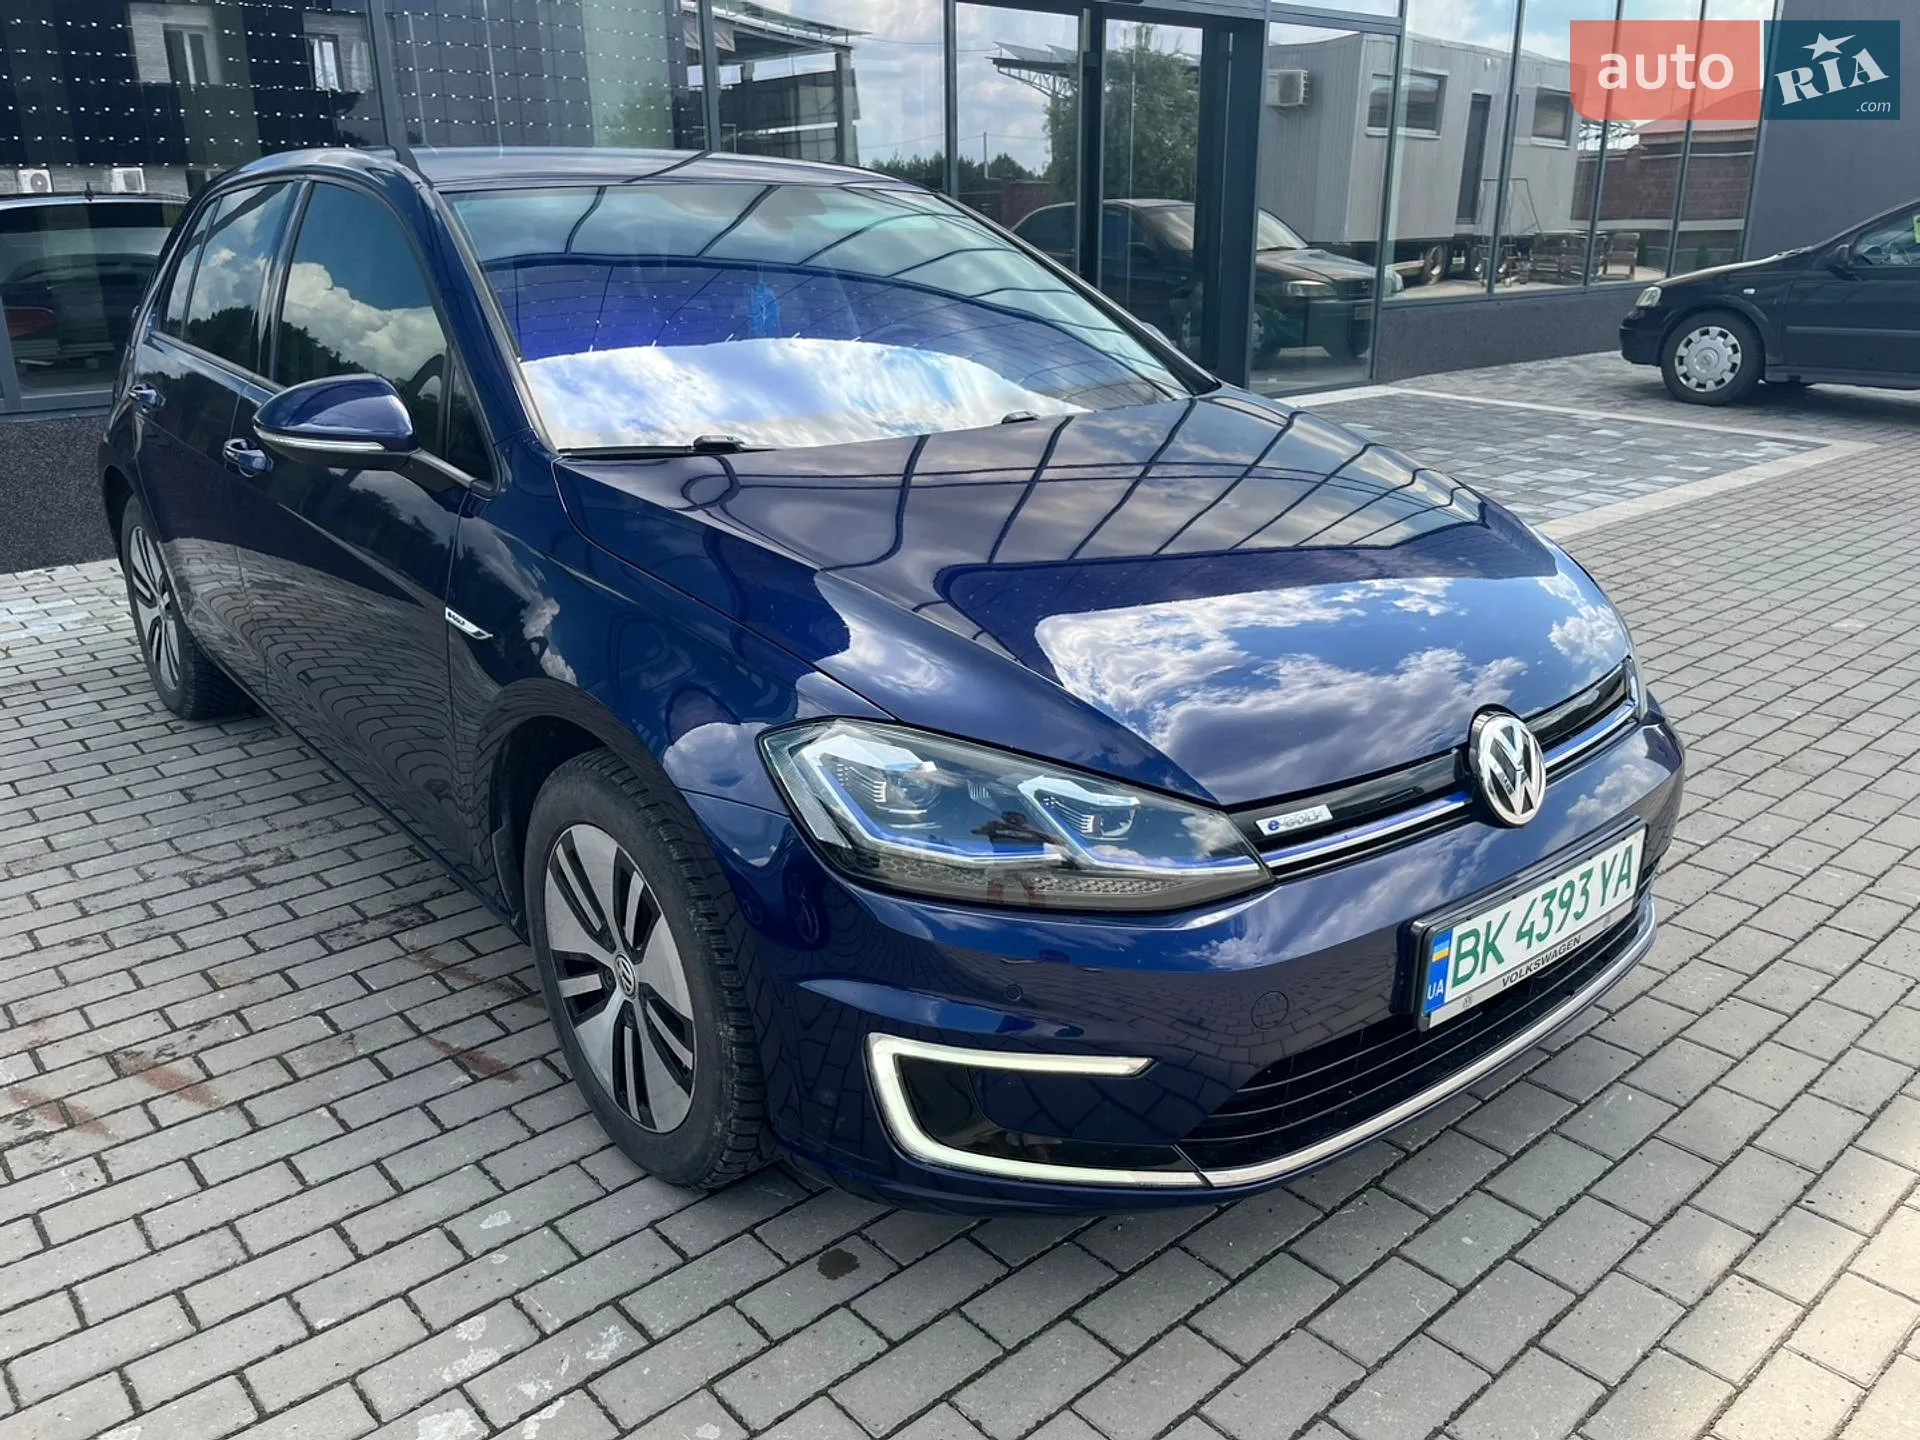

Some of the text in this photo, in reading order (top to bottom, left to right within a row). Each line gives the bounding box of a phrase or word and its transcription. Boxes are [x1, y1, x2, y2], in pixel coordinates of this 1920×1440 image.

[1451, 844, 1633, 989] BK 4393 YA
[1501, 934, 1582, 988] VOLKSWAGEN
[1427, 979, 1444, 1000] UA
